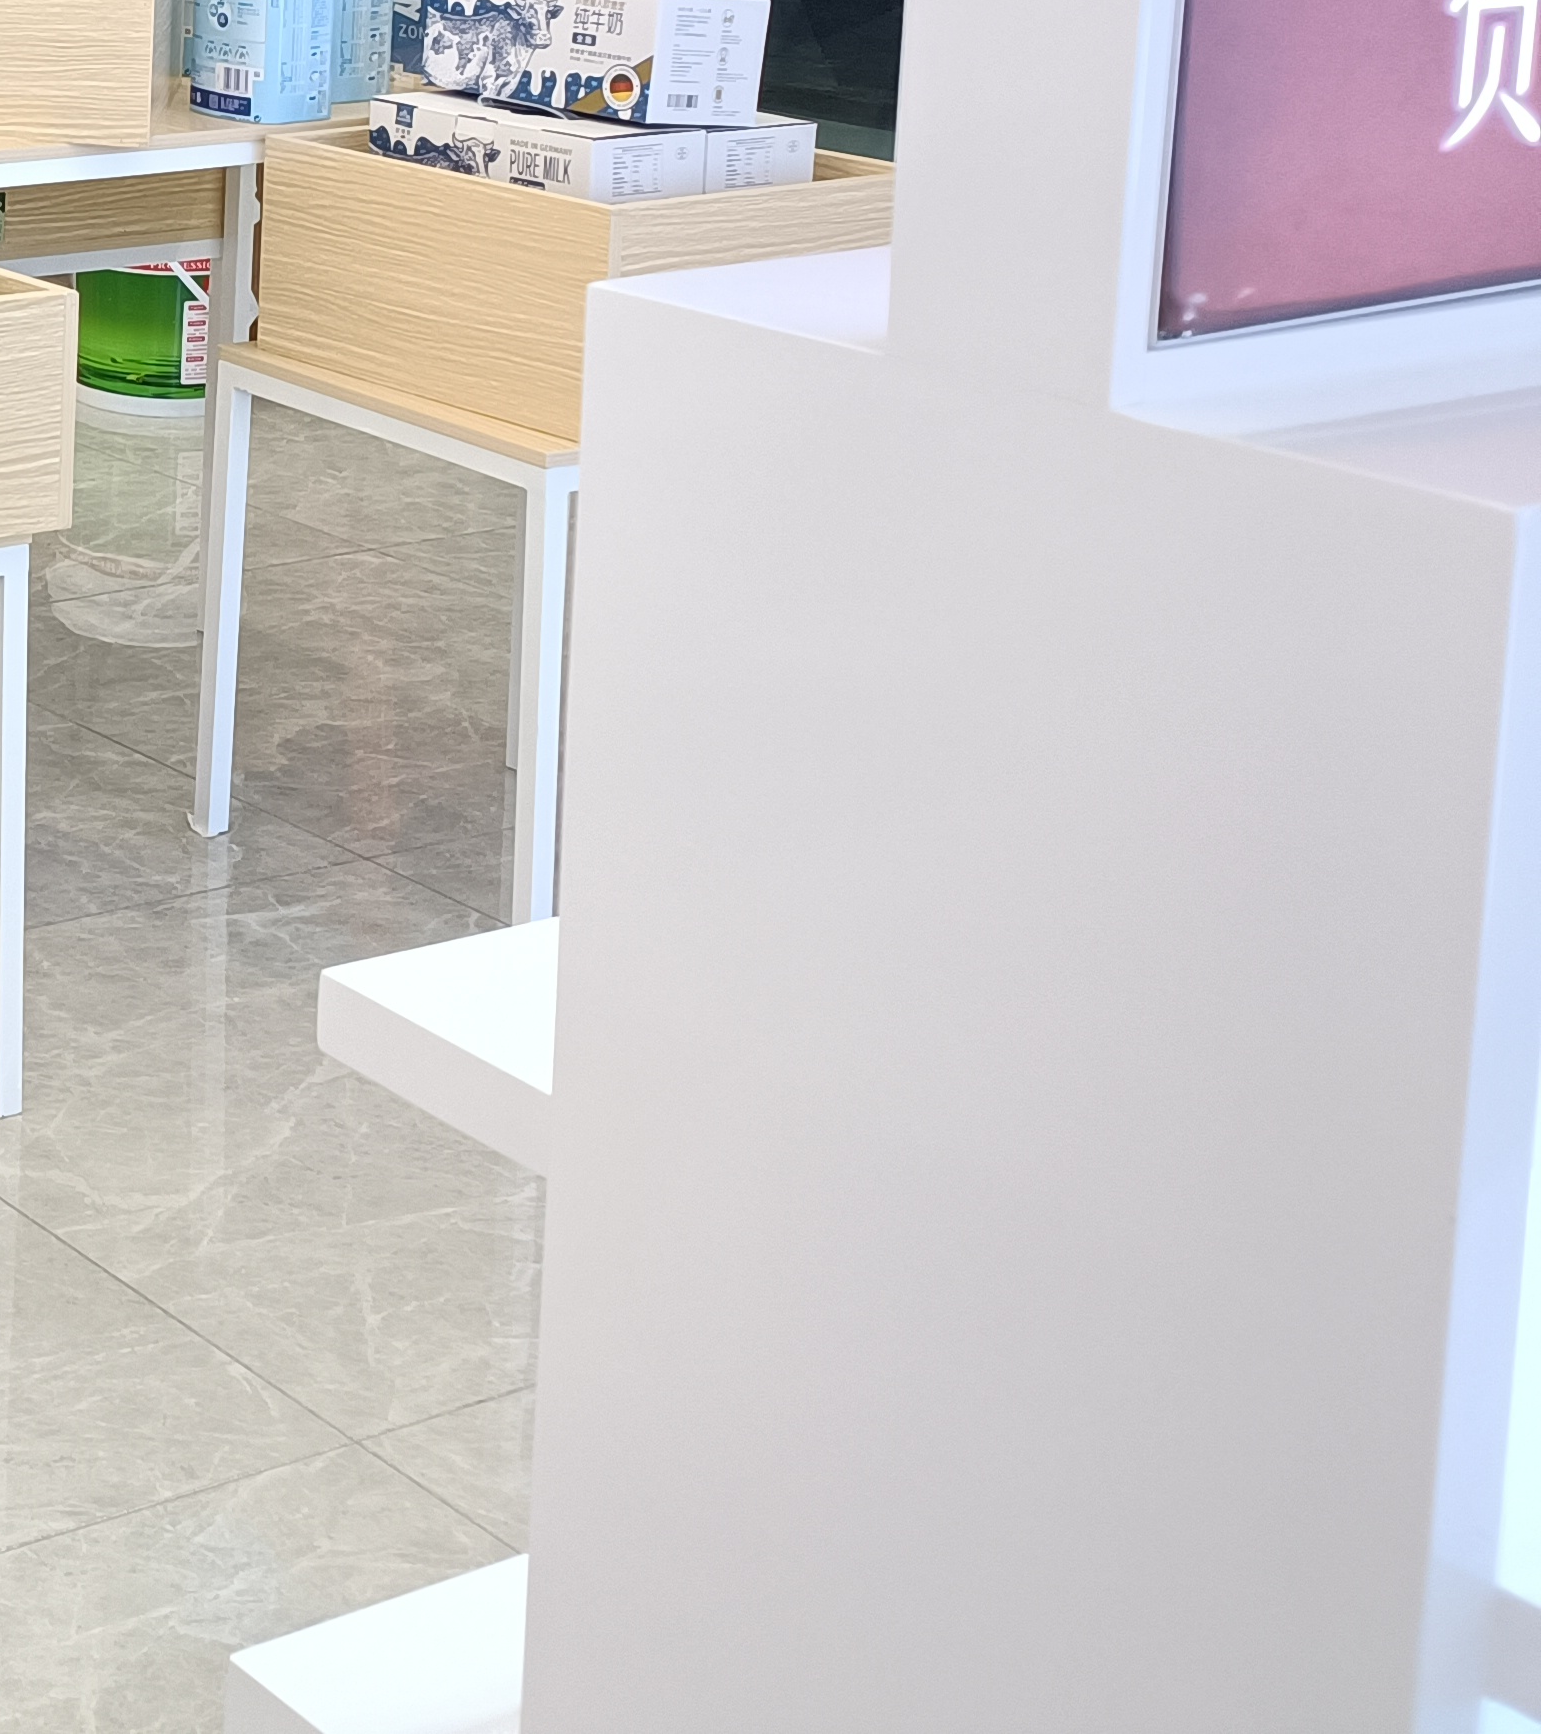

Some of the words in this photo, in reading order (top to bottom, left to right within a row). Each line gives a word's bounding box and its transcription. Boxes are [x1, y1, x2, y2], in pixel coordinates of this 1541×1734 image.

[399, 23, 426, 40] ZON
[573, 6, 624, 36] 纯牛奶
[510, 139, 530, 149] MADE
[539, 143, 574, 157] GERMANY
[509, 148, 541, 180] PURE
[542, 154, 573, 186] MILK
